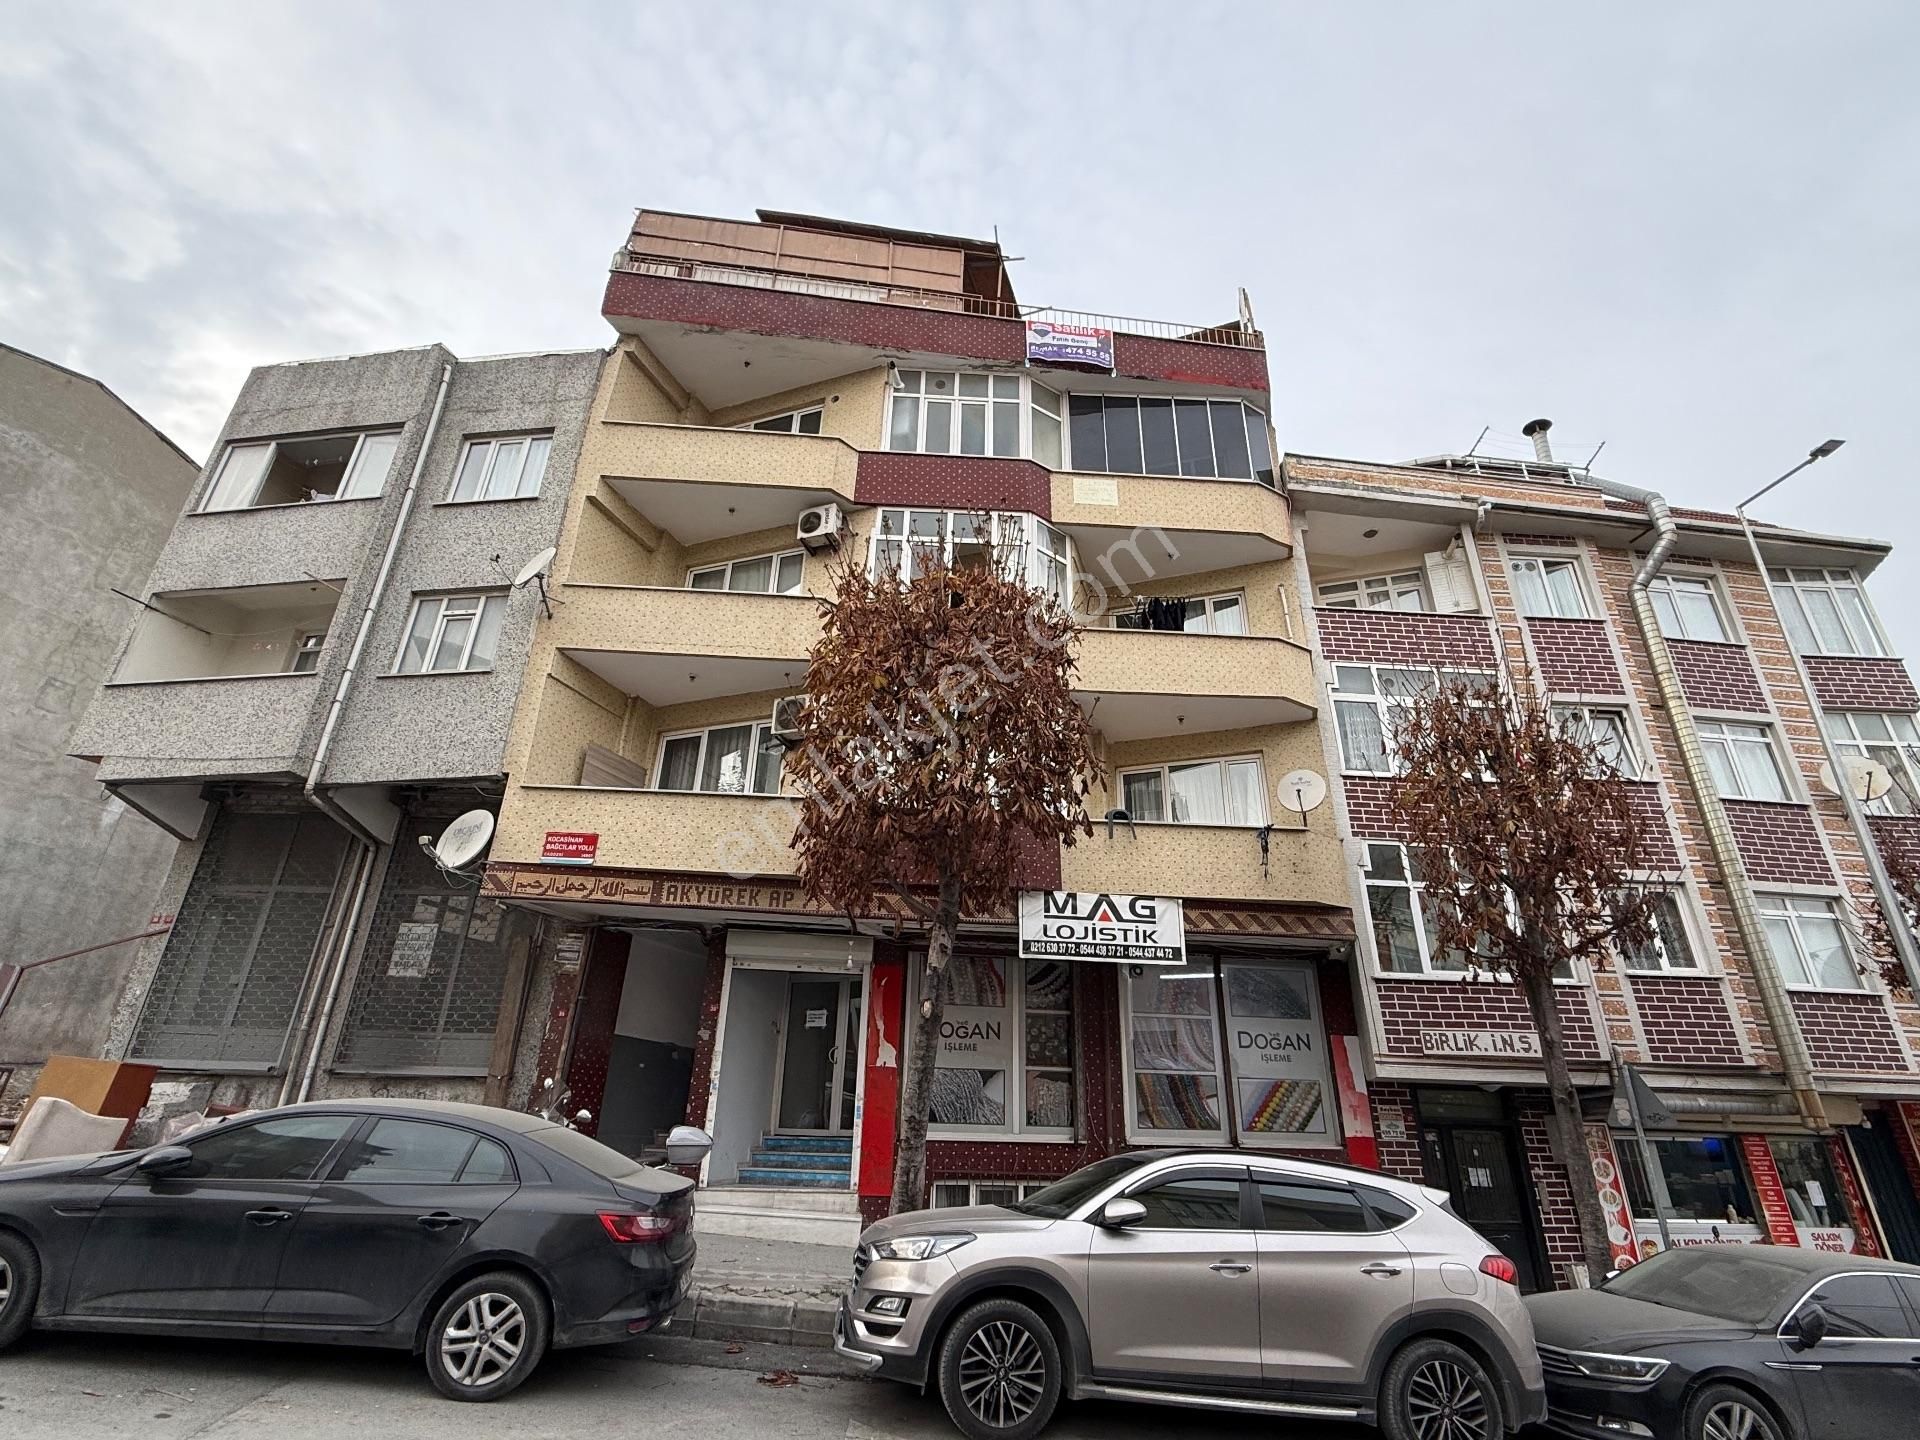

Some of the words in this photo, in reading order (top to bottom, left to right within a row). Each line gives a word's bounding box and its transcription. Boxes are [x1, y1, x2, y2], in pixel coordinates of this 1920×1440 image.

[665, 882, 759, 906] AKYÜREK
[1043, 892, 1157, 922] MAG
[1043, 923, 1159, 944] LOJİSTİK
[1030, 942, 1046, 952] 0212
[1046, 943, 1058, 953] 630
[1058, 943, 1067, 953] 37
[1067, 944, 1076, 954] 72
[1079, 944, 1095, 955] 0544
[1107, 946, 1116, 956] 37
[1117, 946, 1124, 956] 21
[1128, 947, 1143, 957] 0544
[1143, 947, 1155, 957] 437
[1156, 948, 1164, 958] 44
[1164, 948, 1173, 959] 72
[938, 1020, 1001, 1041] OĞAN
[1811, 1232, 1843, 1242] SALKIM
